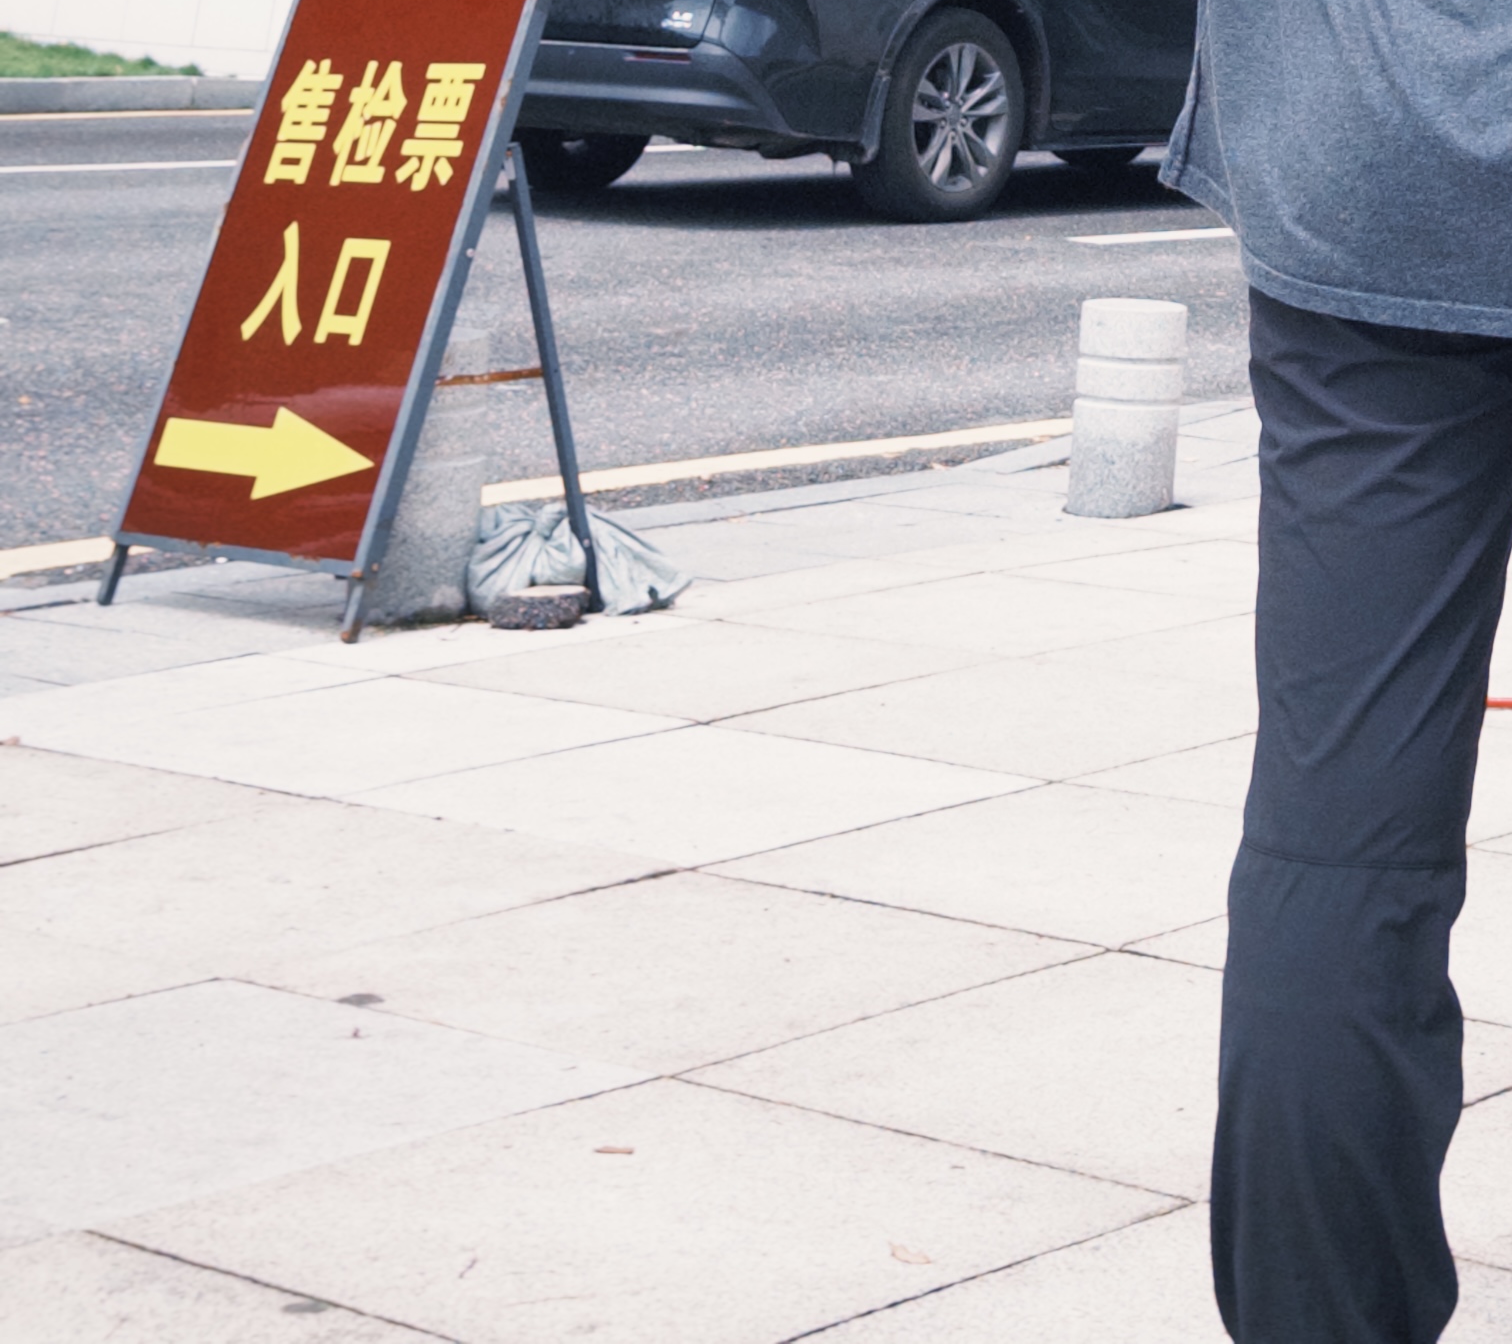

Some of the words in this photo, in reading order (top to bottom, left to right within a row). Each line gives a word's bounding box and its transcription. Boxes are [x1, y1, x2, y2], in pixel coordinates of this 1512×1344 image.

[263, 58, 487, 192] 售检票
[240, 220, 392, 346] 入口
